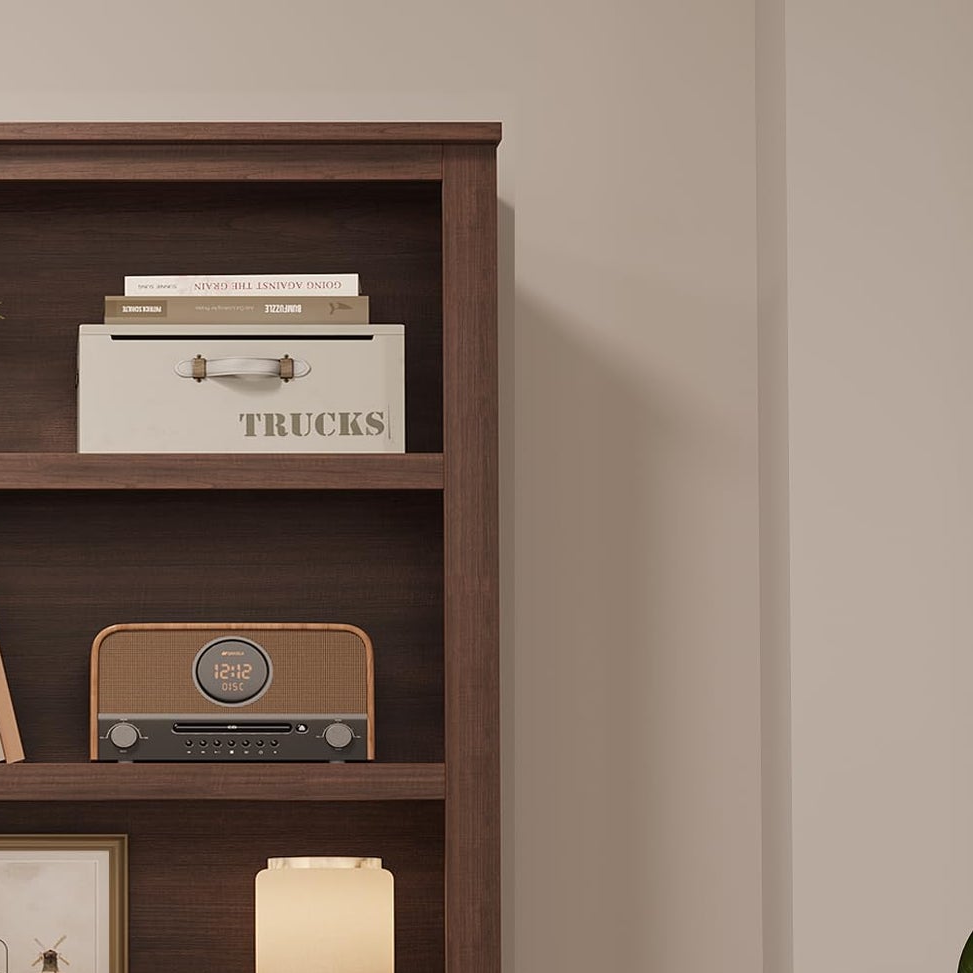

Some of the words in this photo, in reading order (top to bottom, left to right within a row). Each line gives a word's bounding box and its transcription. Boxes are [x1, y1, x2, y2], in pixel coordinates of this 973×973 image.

[193, 281, 229, 291] GRAIN
[232, 280, 253, 291] THE
[255, 279, 304, 290] AGAINST
[307, 279, 342, 290] GOING
[142, 305, 163, 313] PATRICK
[264, 303, 302, 314] BUMFUZZLE
[239, 411, 385, 437] TRUCKS
[214, 663, 252, 680] 12:12
